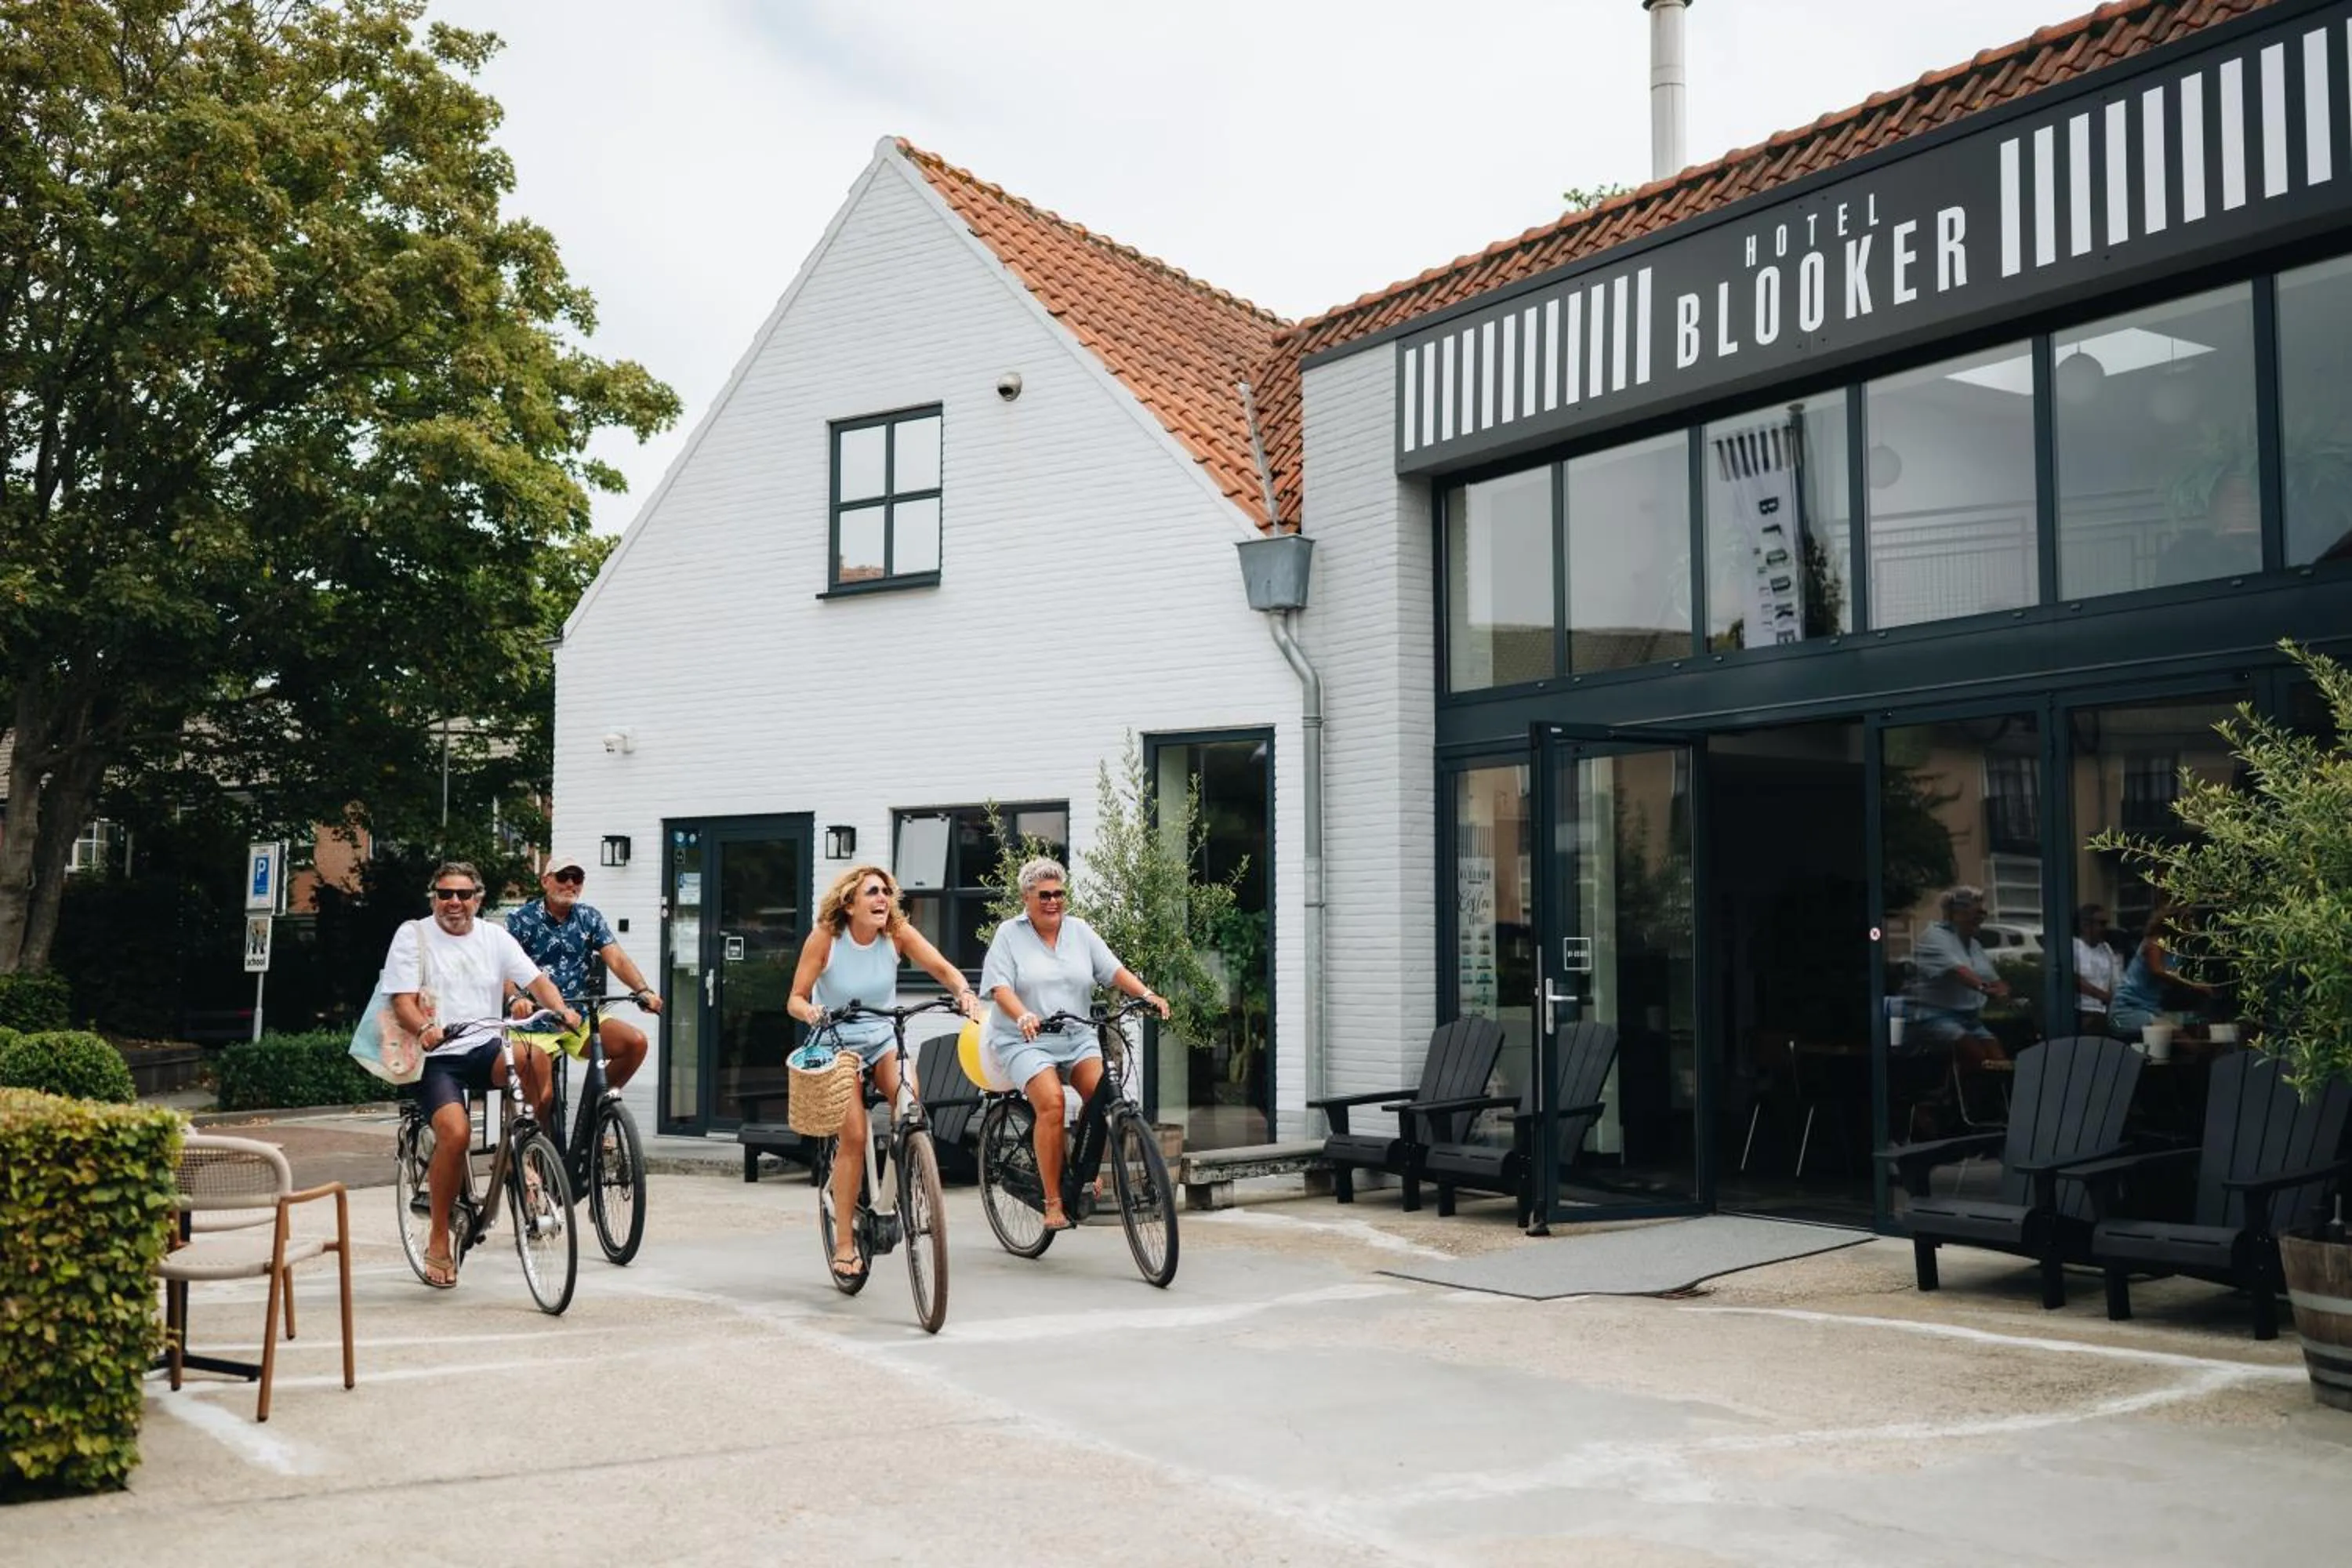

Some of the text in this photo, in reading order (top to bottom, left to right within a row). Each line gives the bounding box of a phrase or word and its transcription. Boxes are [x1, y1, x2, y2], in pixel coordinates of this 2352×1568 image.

[1745, 193, 1879, 268] HOTEL
[1676, 205, 1968, 370] BLOOKER
[256, 859, 267, 880] P
[246, 956, 266, 967] school
